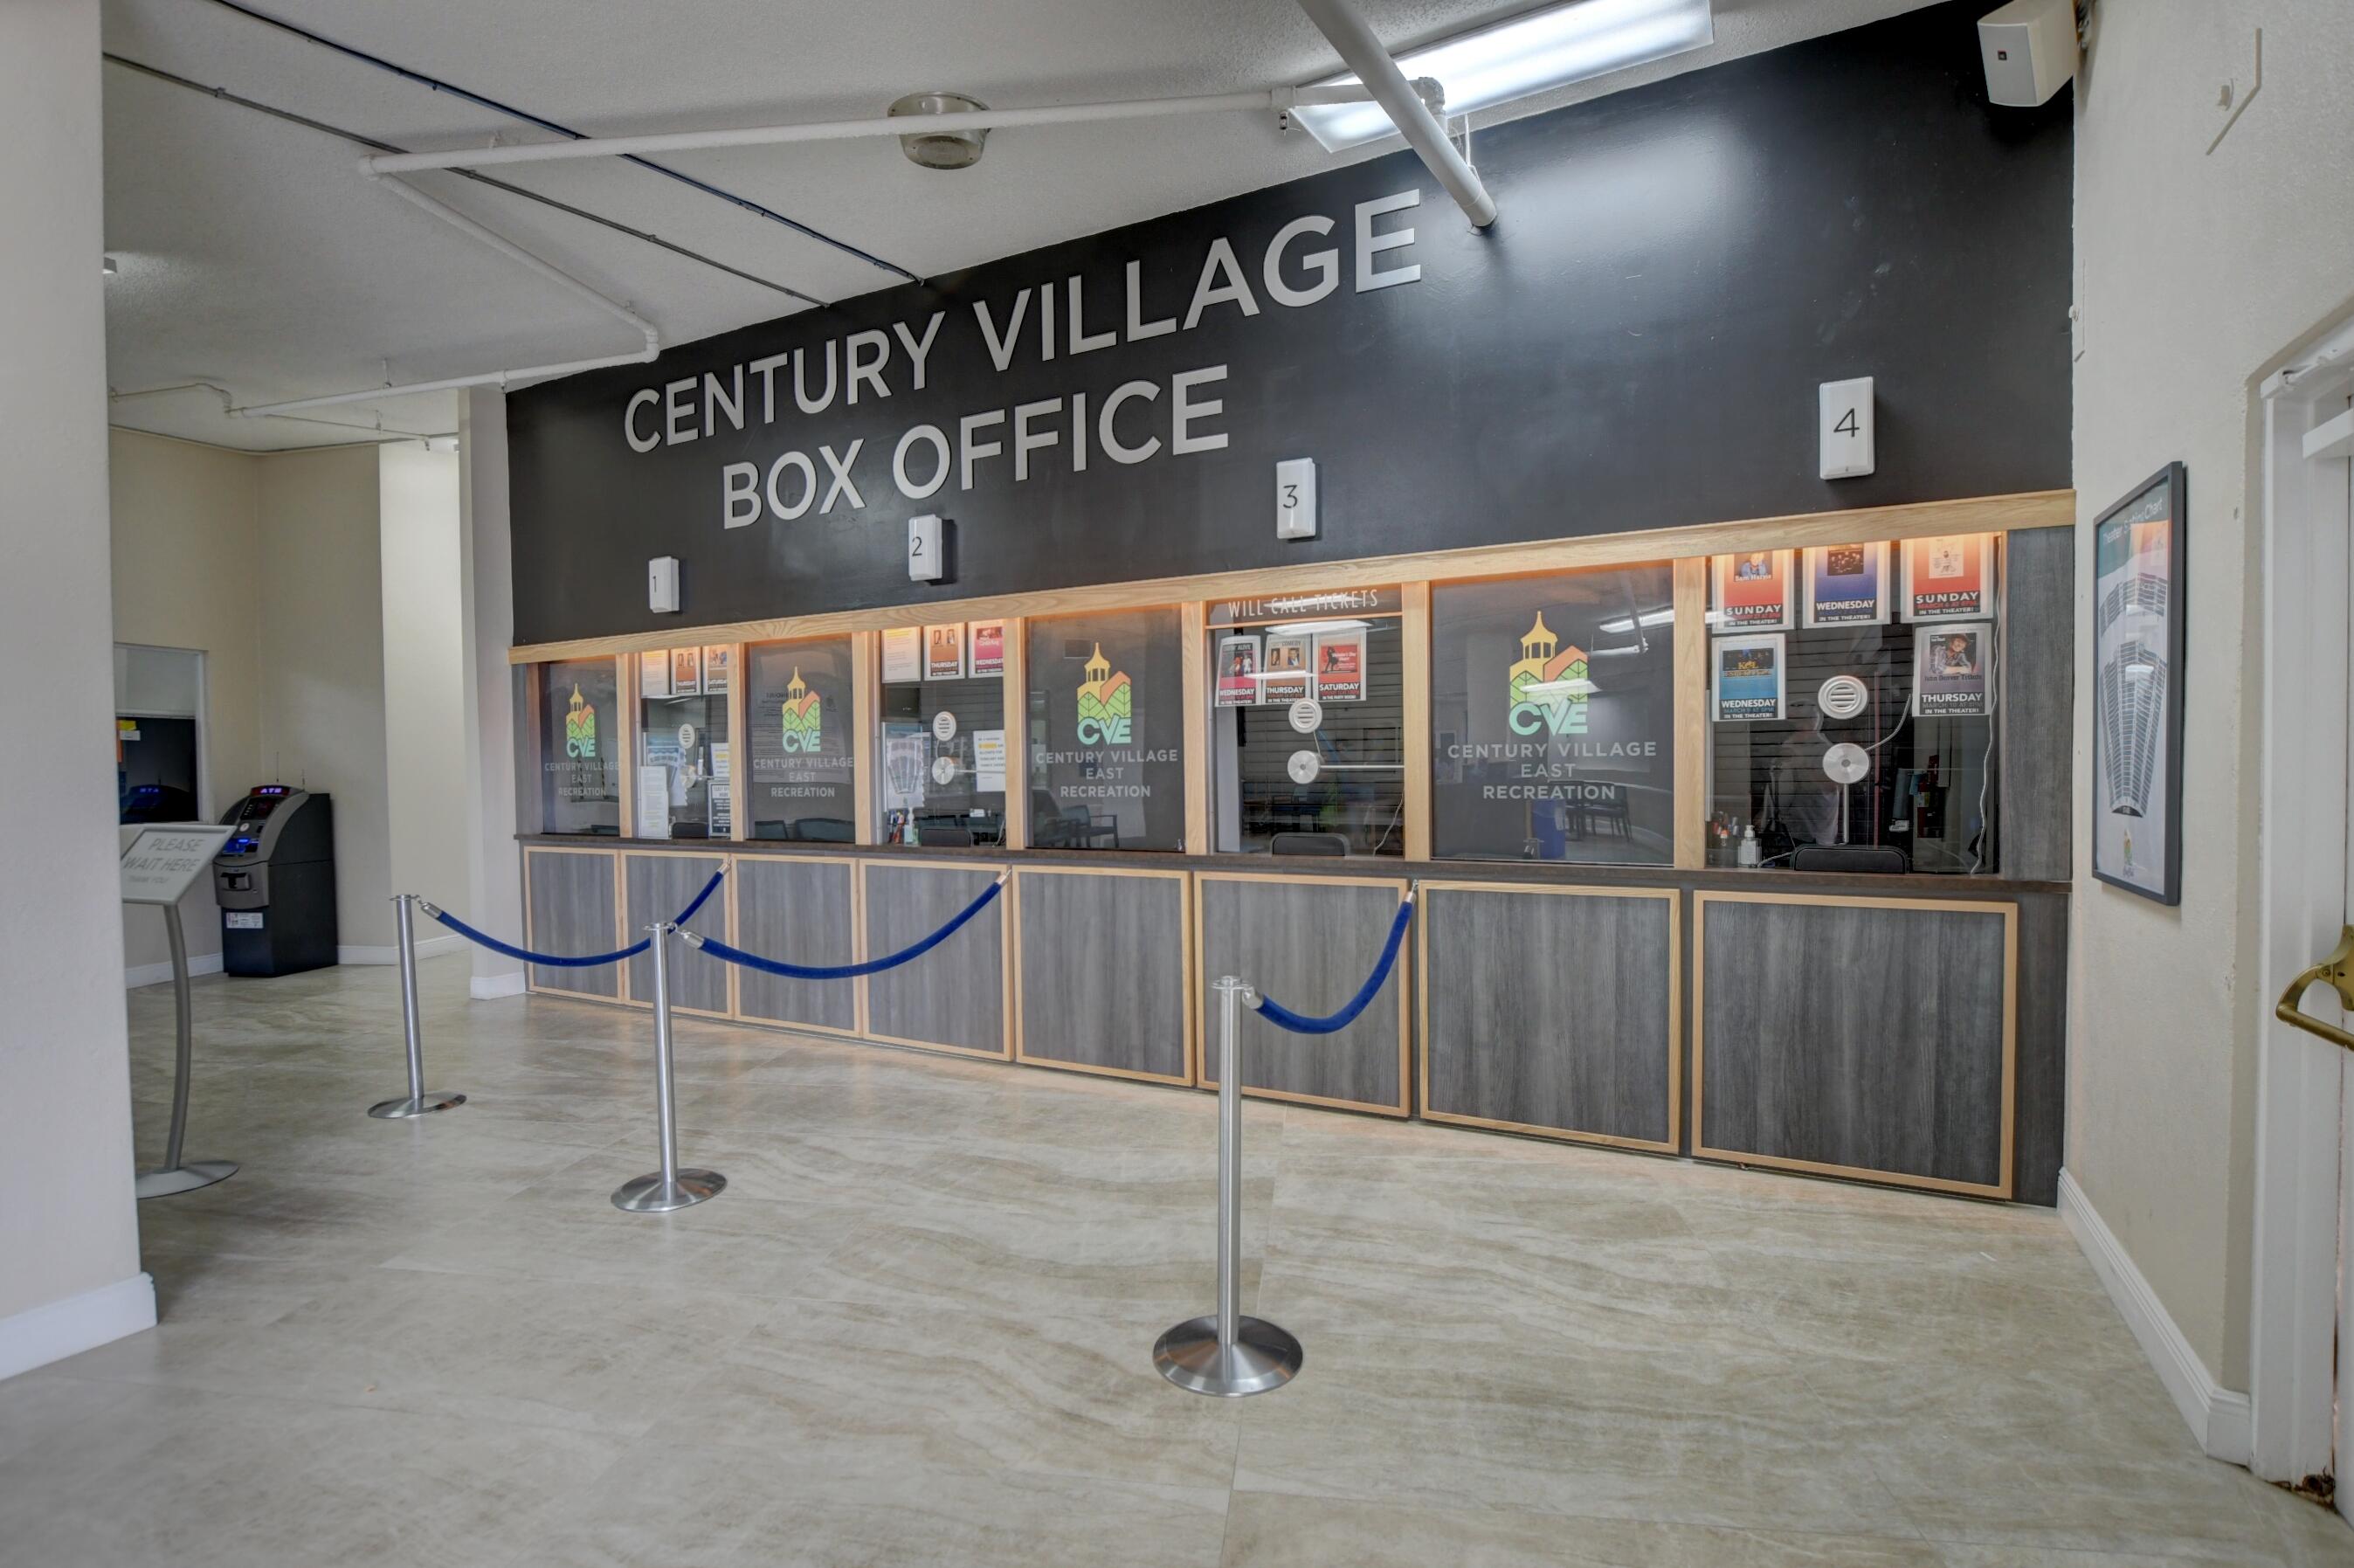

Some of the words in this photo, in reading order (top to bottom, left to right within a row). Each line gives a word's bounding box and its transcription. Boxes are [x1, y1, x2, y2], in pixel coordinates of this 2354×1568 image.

[624, 310, 946, 453] CENTURY
[973, 188, 1422, 373] VILLAGE
[1833, 408, 1860, 437] 4
[722, 439, 866, 530] BOX
[892, 363, 1229, 500] OFFICE
[1281, 484, 1298, 509] 3
[910, 536, 922, 557] 2
[651, 574, 658, 593] 1
[1228, 599, 1264, 618] WILL
[1271, 594, 1307, 615] CALL
[1315, 589, 1377, 611] TICKETS
[1916, 591, 1978, 604] SUNDAY
[1726, 604, 1782, 616] SUNDAY
[1817, 599, 1874, 611] WEDNESDAY
[1219, 687, 1255, 696] WEDNESDAY
[1921, 693, 1983, 702] THURSDAY
[1722, 699, 1777, 708] WEDNESDAY
[1508, 697, 1588, 736] CVE
[1077, 713, 1132, 745] CVE
[566, 736, 596, 757] CVE
[783, 727, 821, 753] CVE
[1036, 751, 1104, 764] CENTURY
[1110, 749, 1178, 763] VILLAGE
[1447, 743, 1547, 758] CENTURY
[1557, 742, 1657, 756] VILLAGE
[544, 762, 581, 772] CENTURY
[753, 758, 803, 769] CENTURY
[806, 757, 853, 768] VILLAGE
[1521, 763, 1577, 777] EAST
[571, 774, 592, 783] EAST
[789, 772, 818, 782] EAST
[1086, 767, 1123, 780] EAST
[558, 786, 606, 797] RECREATION
[770, 787, 835, 798] RECREATION
[1060, 784, 1151, 798] RECREATION
[1483, 784, 1615, 799] RECREATION
[148, 838, 205, 852] PLEASE
[124, 857, 163, 870] WAIT
[161, 858, 200, 872] HERE
